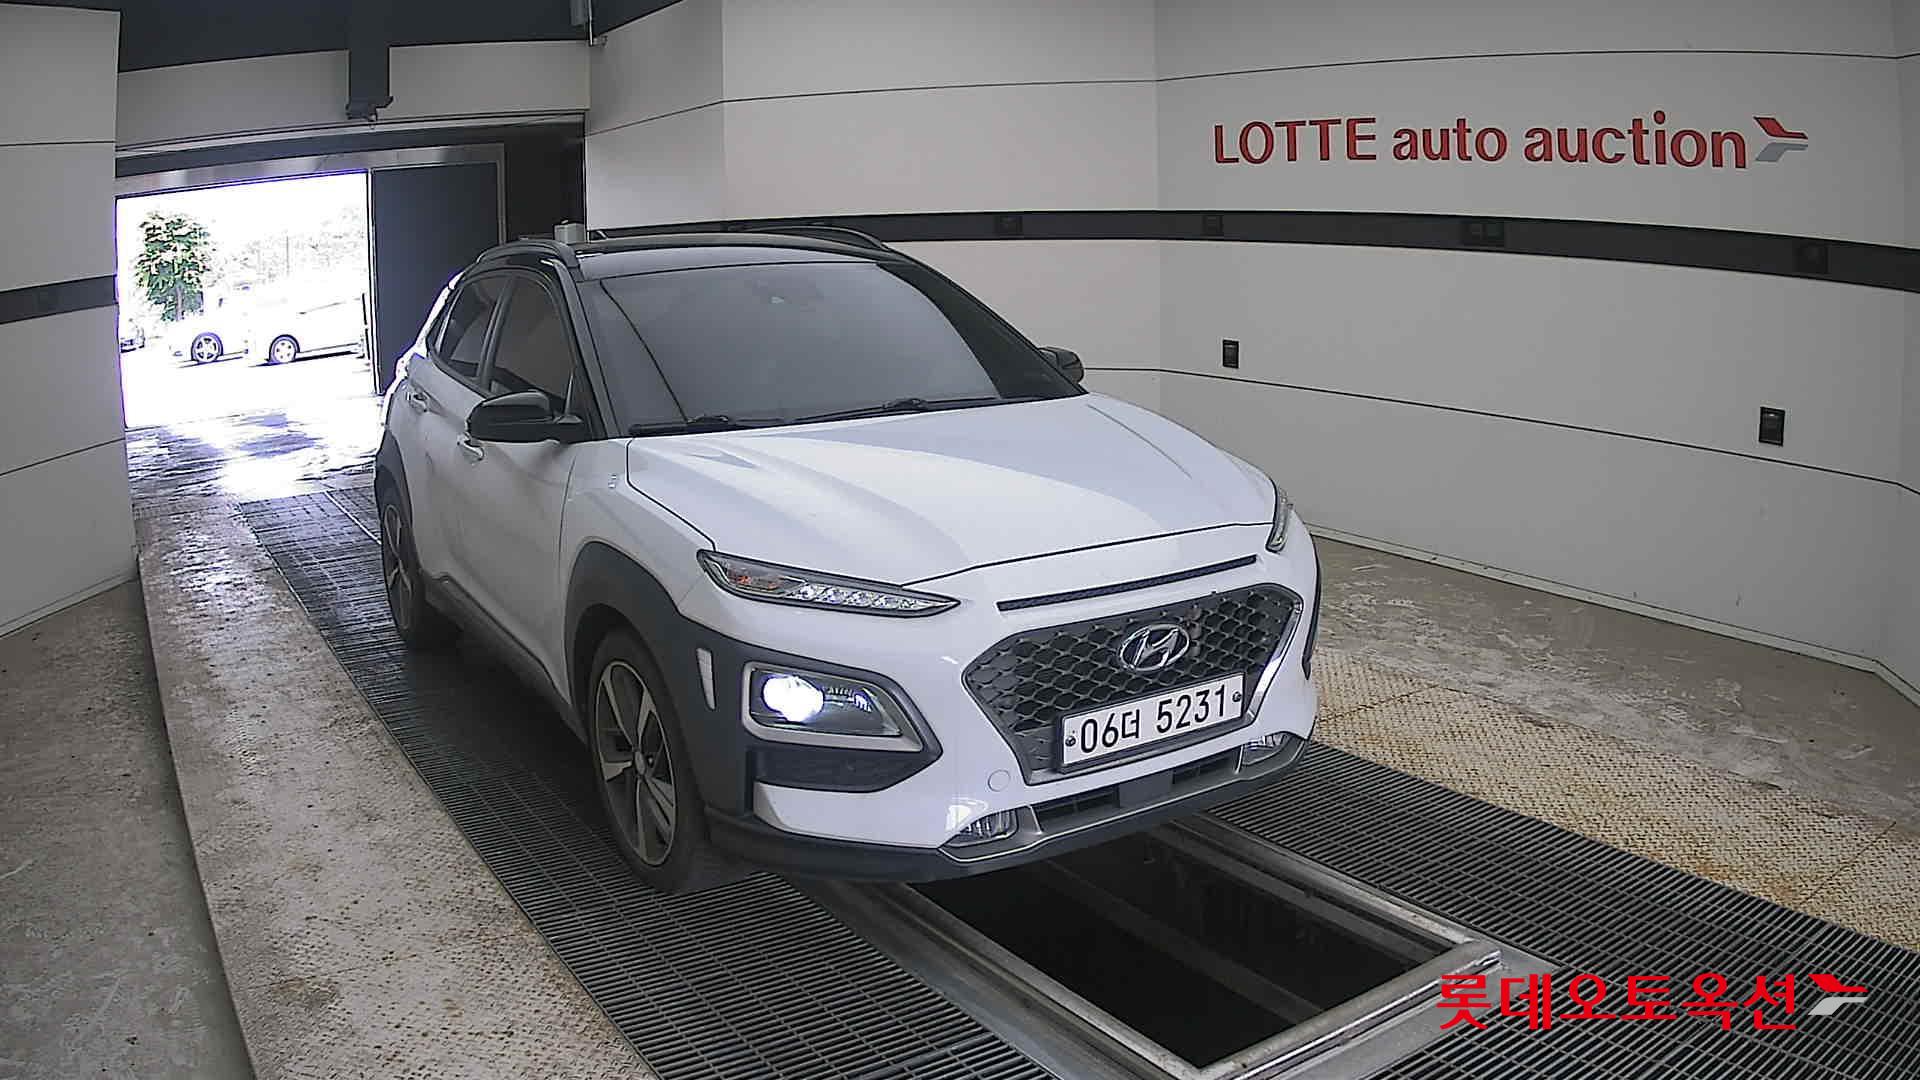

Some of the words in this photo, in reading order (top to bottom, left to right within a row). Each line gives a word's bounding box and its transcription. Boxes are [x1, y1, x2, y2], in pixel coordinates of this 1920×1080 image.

[1214, 117, 1377, 164] LOTTE
[1392, 118, 1508, 162] auto
[1524, 110, 1747, 168] auction
[1080, 709, 1140, 753] 06더
[1156, 684, 1225, 733] 5231
